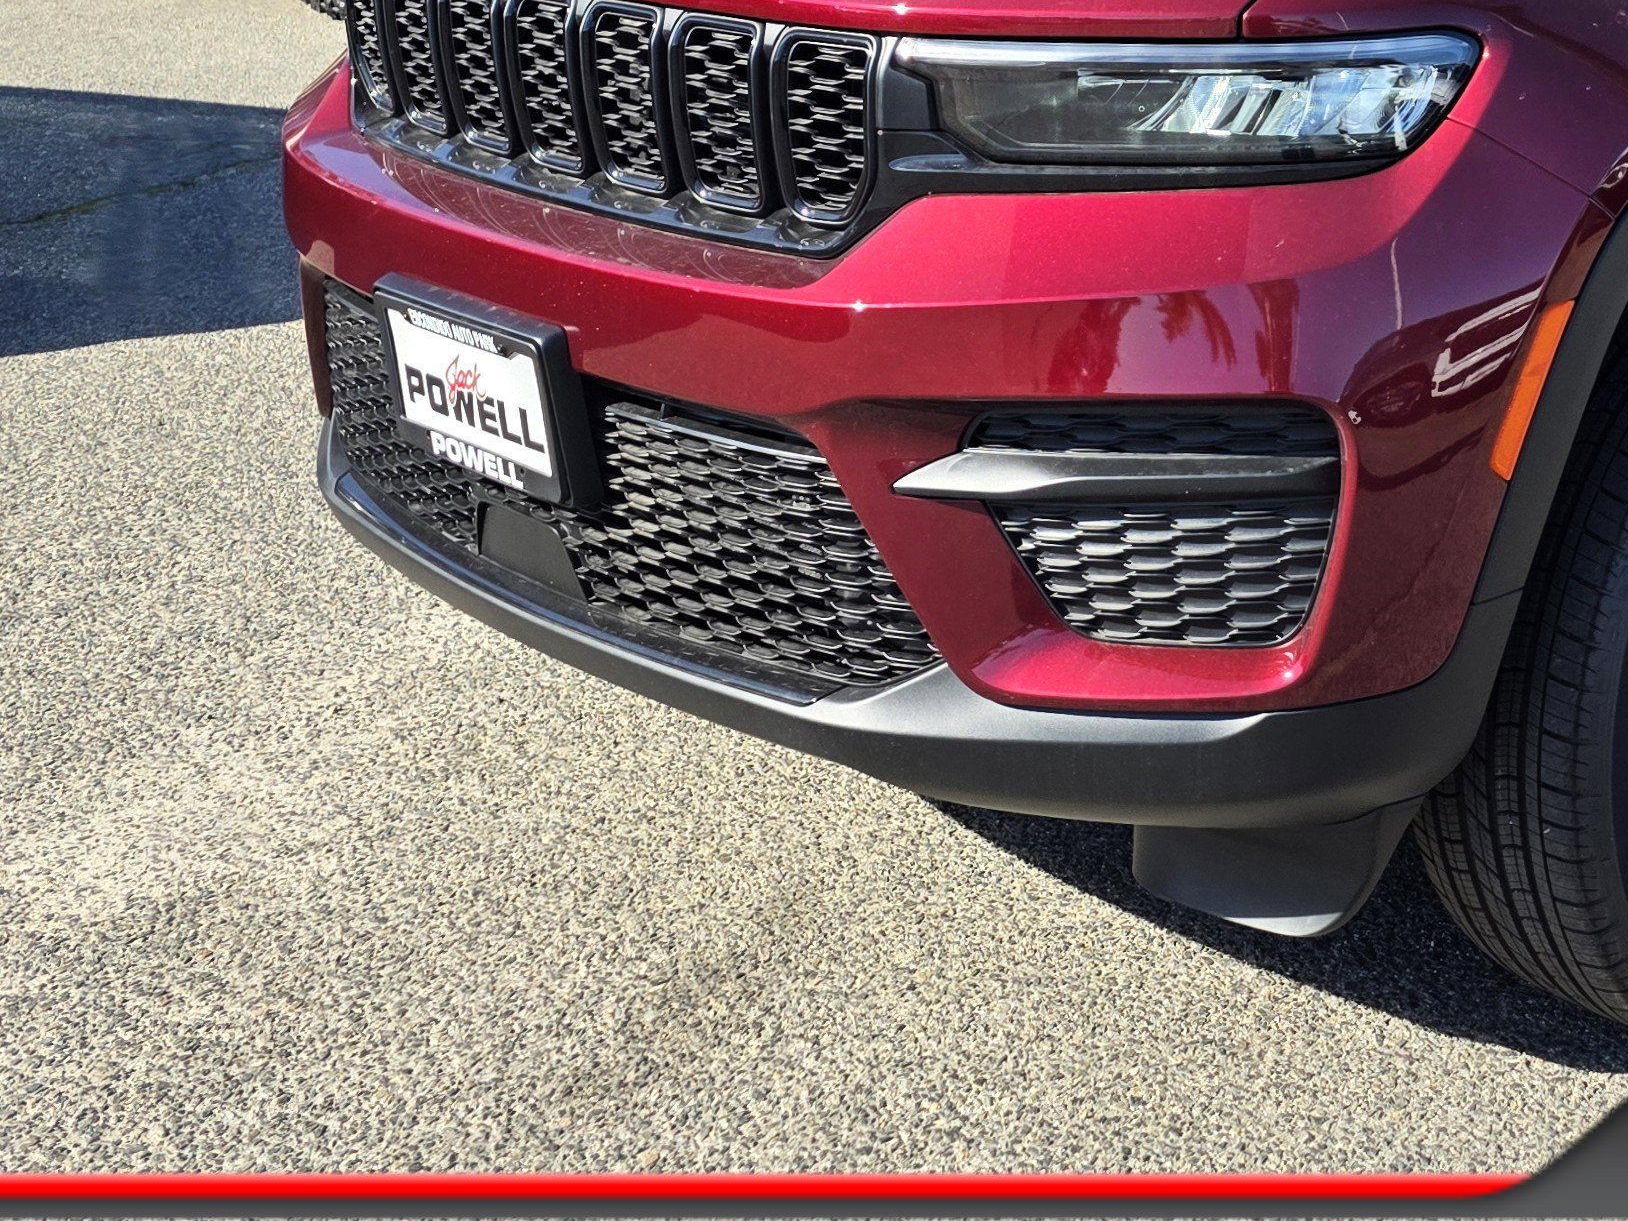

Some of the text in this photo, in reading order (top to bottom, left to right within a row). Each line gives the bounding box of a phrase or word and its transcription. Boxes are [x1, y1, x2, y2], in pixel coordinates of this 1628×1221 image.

[404, 363, 545, 454] POWELL
[446, 354, 487, 405] Jack
[430, 430, 524, 490] POWELL
